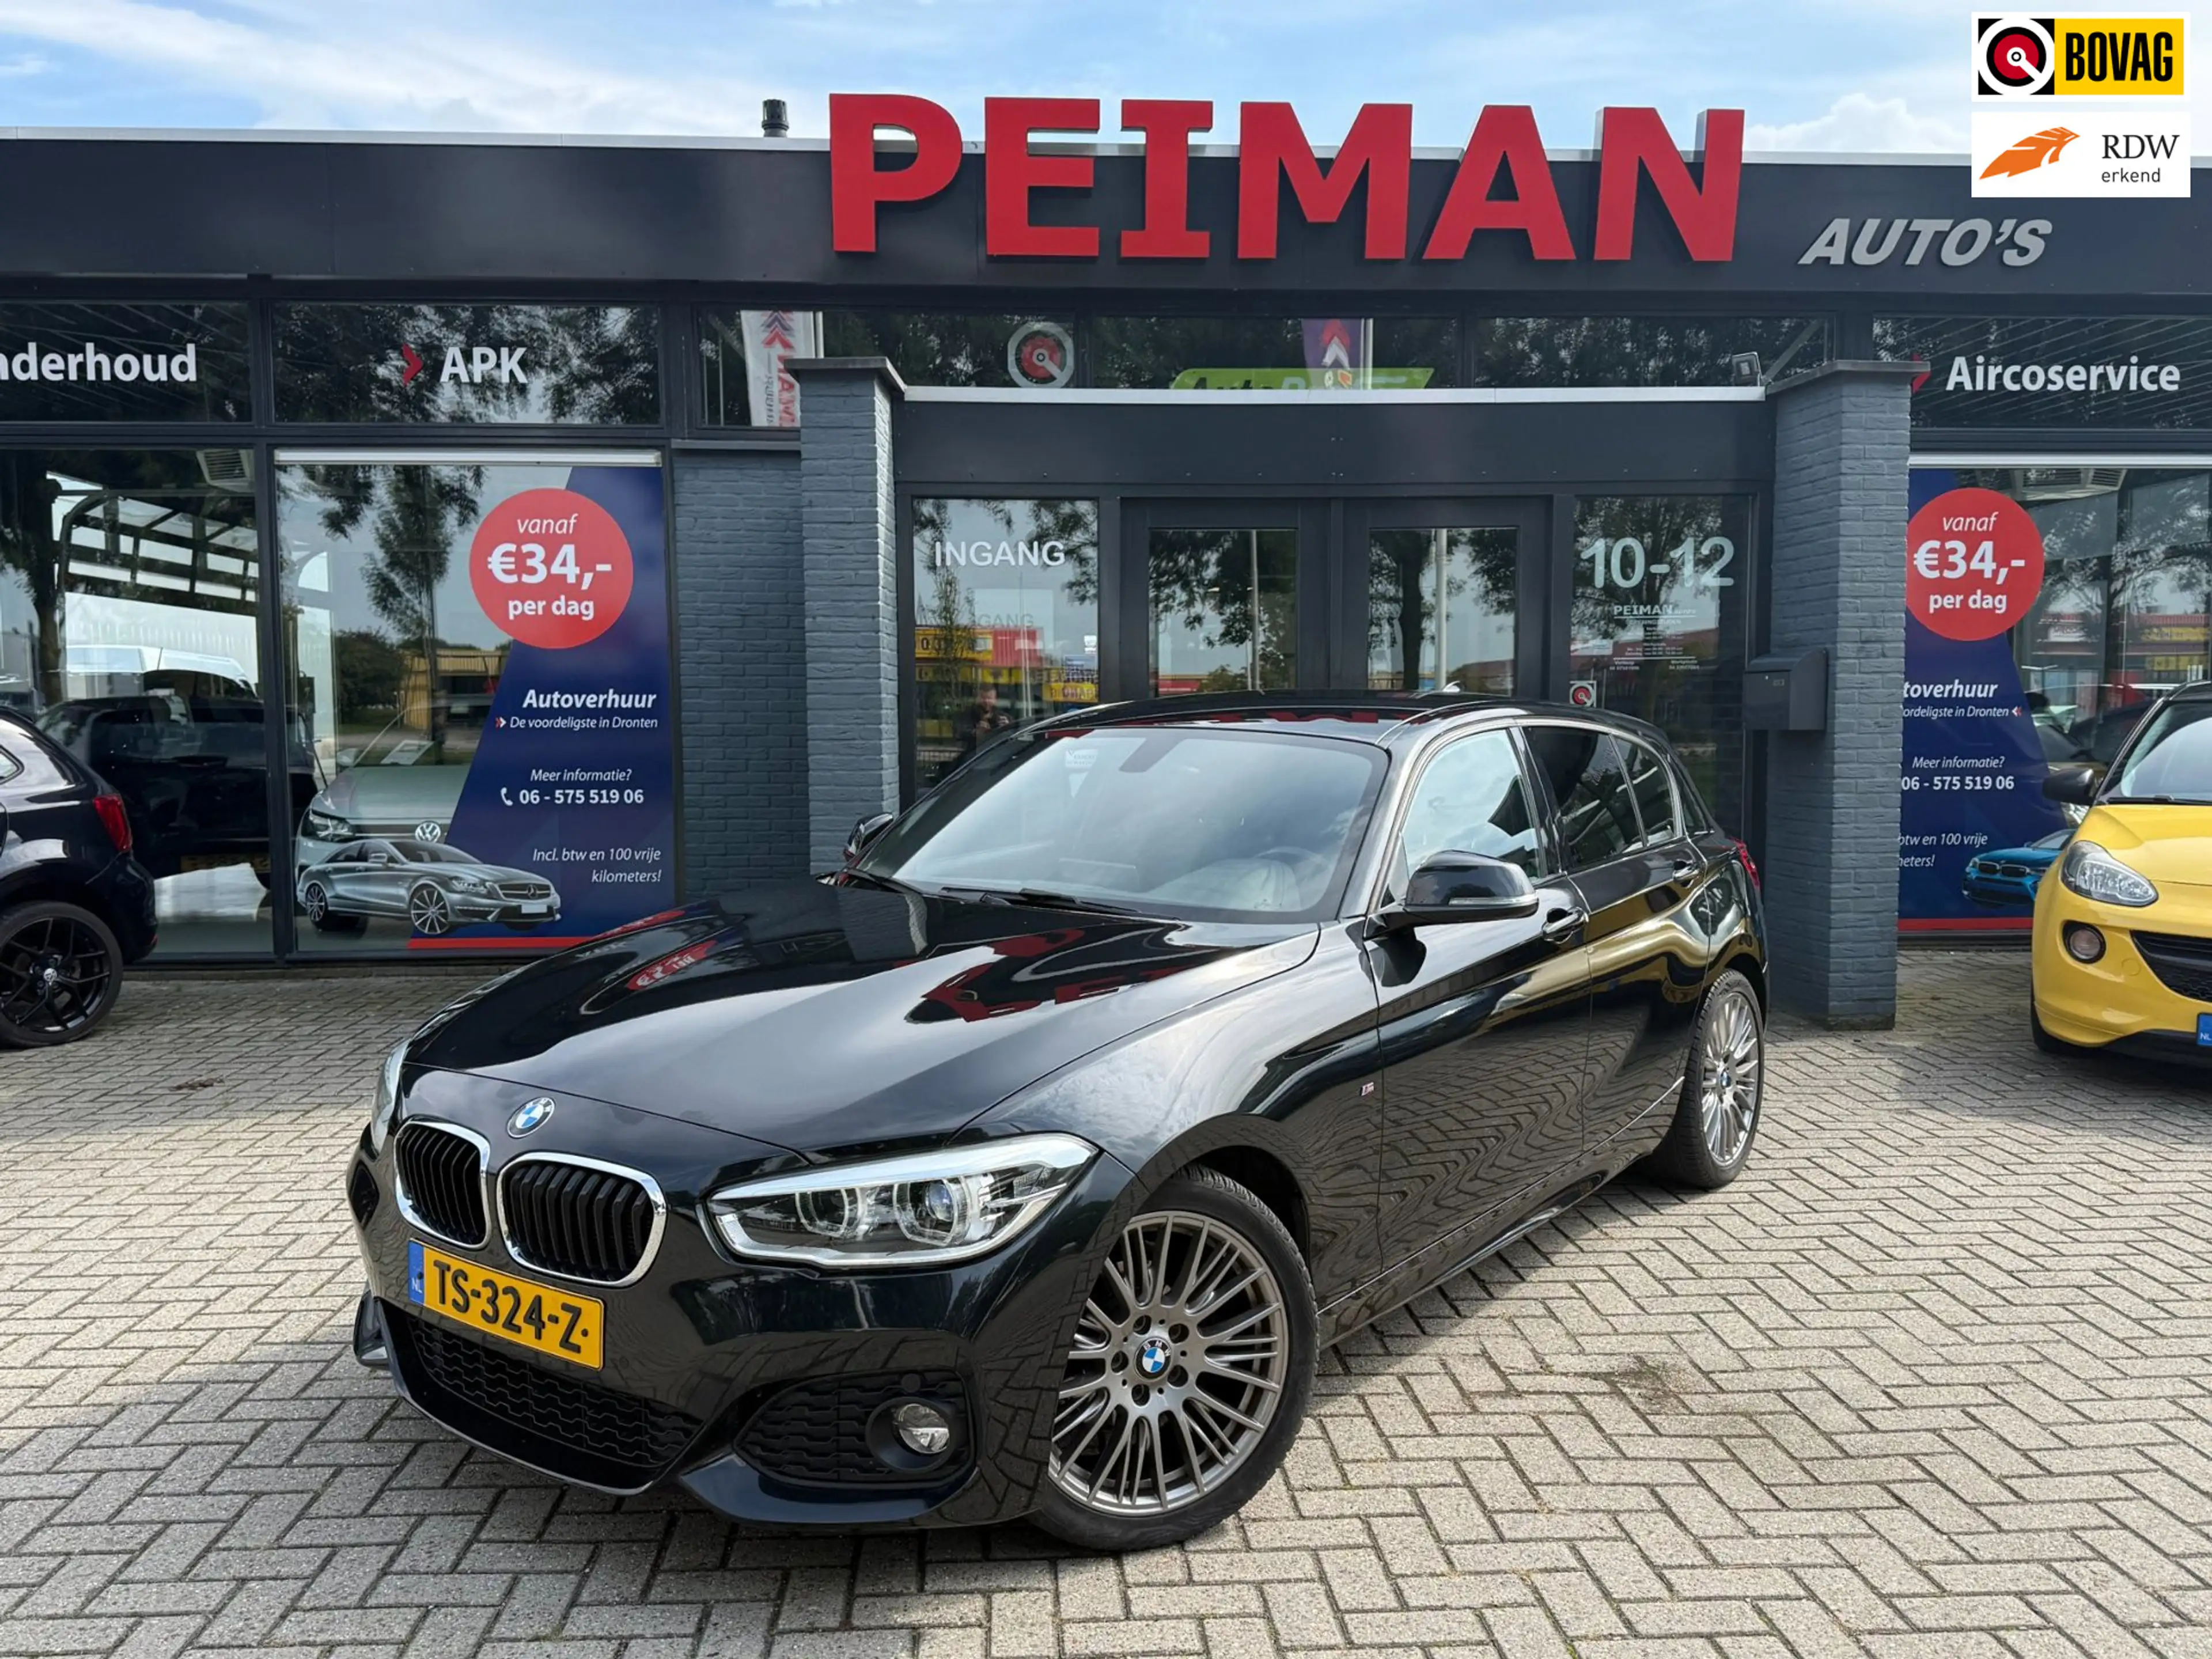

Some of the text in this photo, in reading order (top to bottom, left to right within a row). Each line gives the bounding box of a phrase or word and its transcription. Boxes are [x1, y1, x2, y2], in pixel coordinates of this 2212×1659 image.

[830, 93, 1745, 262] PEIMAN
[1797, 218, 2052, 266] AUTO'S
[440, 347, 527, 383] APK
[1946, 355, 2180, 391] Aircoservice
[517, 514, 578, 534] vanaf
[1942, 512, 1999, 532] vanaf
[935, 541, 1065, 566] INGANG
[1580, 537, 1734, 588] 10-12
[1913, 541, 2025, 585] €34,-
[487, 543, 612, 590] €34,-
[508, 596, 594, 621] per dag
[1613, 605, 1673, 615] PEIMAN
[1929, 590, 2008, 614] per dag
[522, 688, 656, 709] Autoverhuur
[1903, 679, 1998, 698] toverhuur
[1903, 705, 2009, 719] ordeligste in Dronten
[510, 716, 658, 731] De voordeligste in Dronten
[1912, 756, 2005, 768] Meer informatie?
[530, 768, 632, 781] Meer informatie?
[1901, 777, 1920, 790] 06
[1933, 777, 1960, 790] 575
[1964, 776, 1992, 790] 519
[1995, 776, 2014, 790] 06
[519, 789, 540, 804] 06
[554, 789, 585, 804] 575
[589, 789, 619, 804] 519
[623, 789, 644, 804] 06
[1922, 836, 1936, 845] en
[1941, 833, 1961, 845] 100
[1963, 832, 1988, 848] vrije
[533, 847, 661, 863] Incl. btw en 100 vrije
[1899, 854, 1936, 867] eters!
[592, 869, 662, 882] kilometers!
[411, 1277, 423, 1294] NL
[433, 1259, 581, 1354] TS-324-Z
